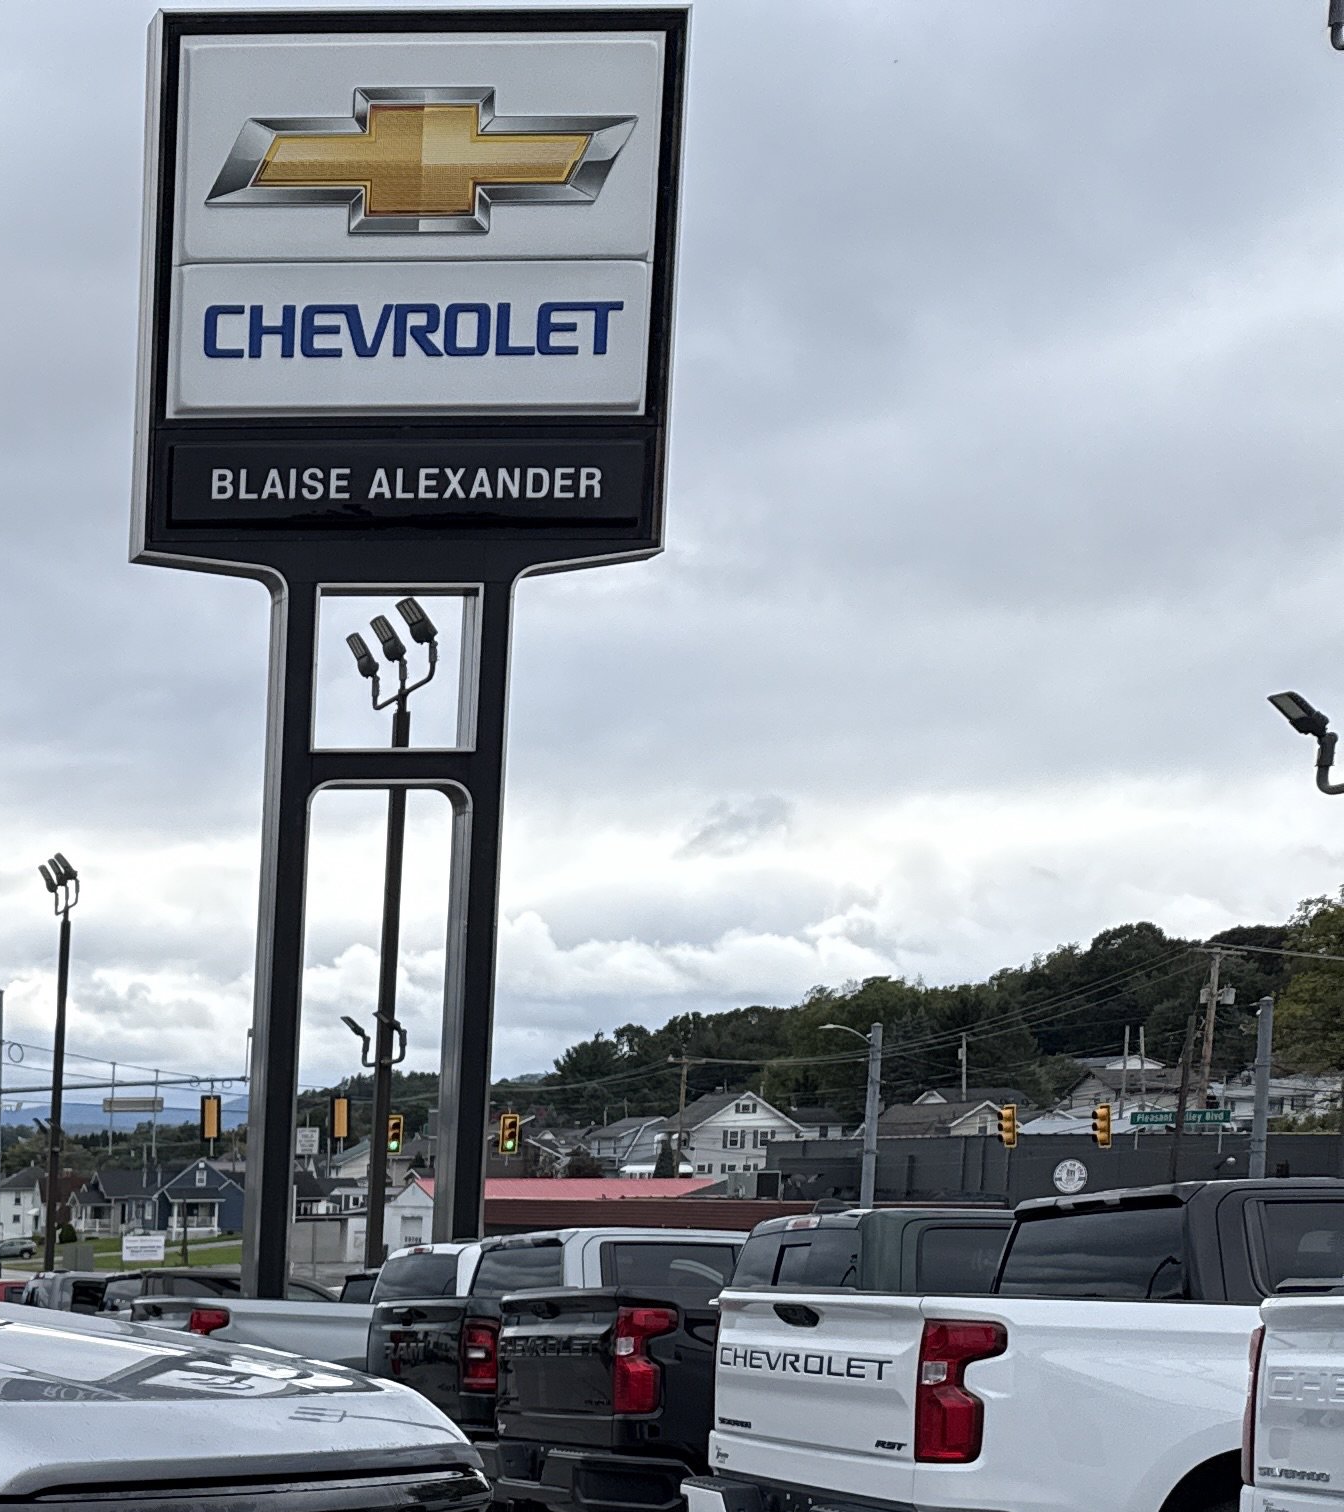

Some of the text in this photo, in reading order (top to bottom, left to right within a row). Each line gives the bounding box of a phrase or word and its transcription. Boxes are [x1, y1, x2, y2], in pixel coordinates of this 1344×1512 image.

[203, 300, 625, 359] CHEVROLET
[211, 466, 603, 501] BLAISE ALEXANDER
[719, 1346, 893, 1381] CHEVROLET
[874, 1439, 908, 1451] RST
